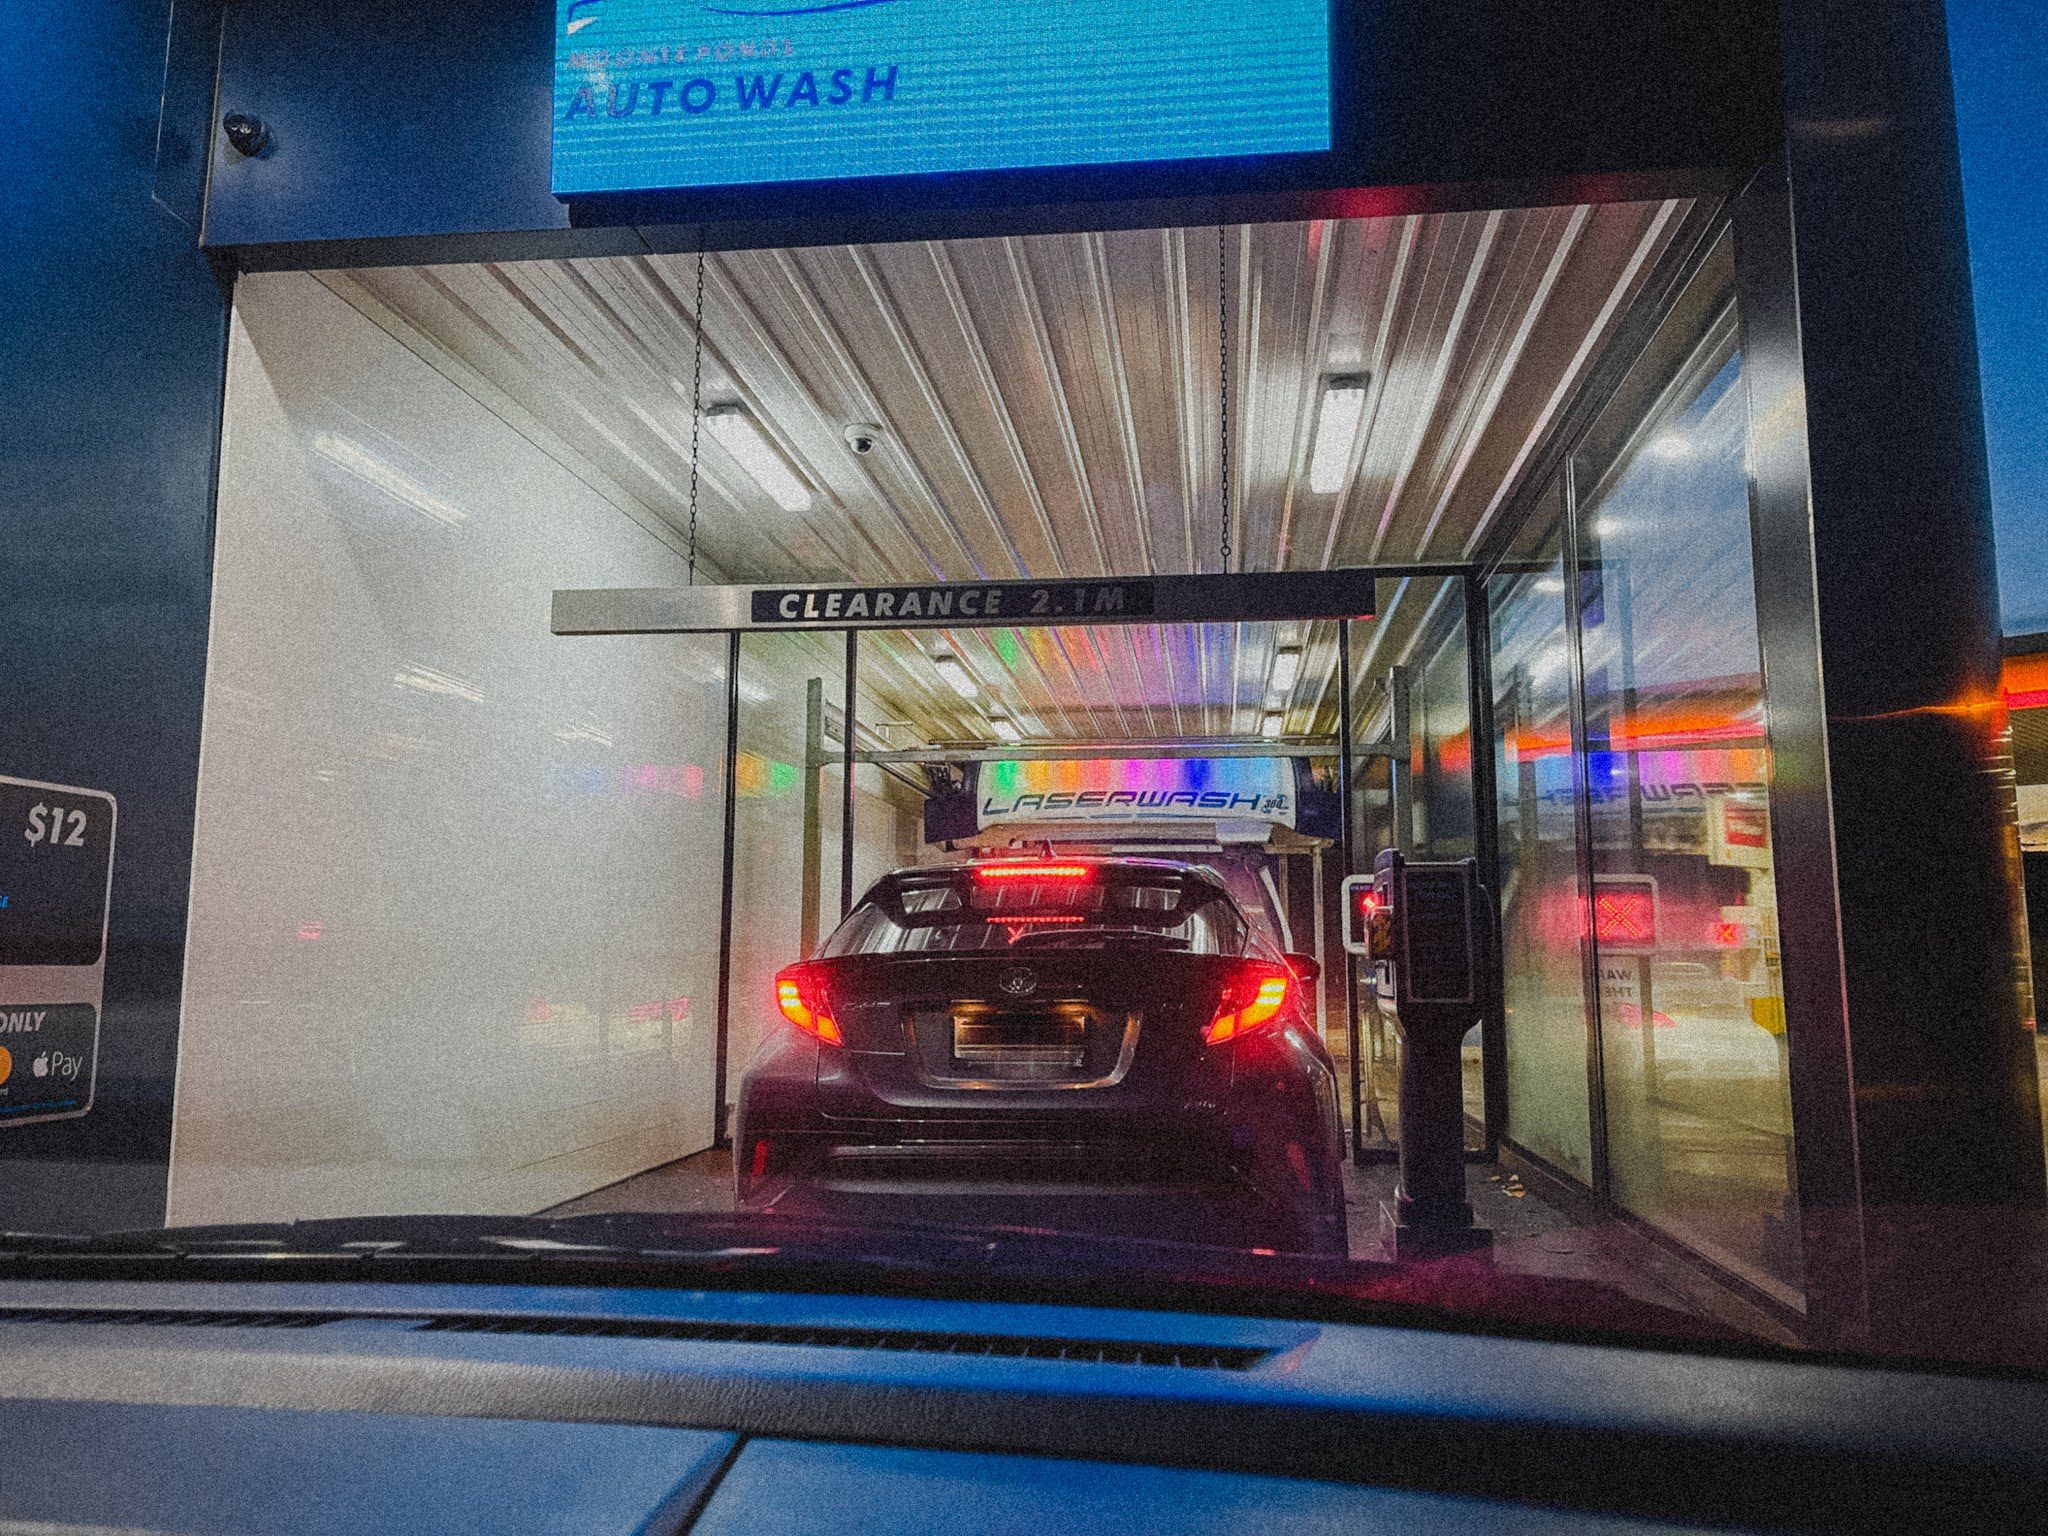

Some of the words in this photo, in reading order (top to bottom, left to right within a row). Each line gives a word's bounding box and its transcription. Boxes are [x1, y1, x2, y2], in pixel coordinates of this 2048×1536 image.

[564, 79, 717, 120] AUTO
[736, 66, 898, 111] WASH
[778, 589, 1001, 618] CLEARANCE
[1031, 587, 1125, 613] 2.1M
[982, 791, 1263, 816] LASERWASH
[24, 802, 87, 847] $12
[51, 1050, 83, 1081] Pay
